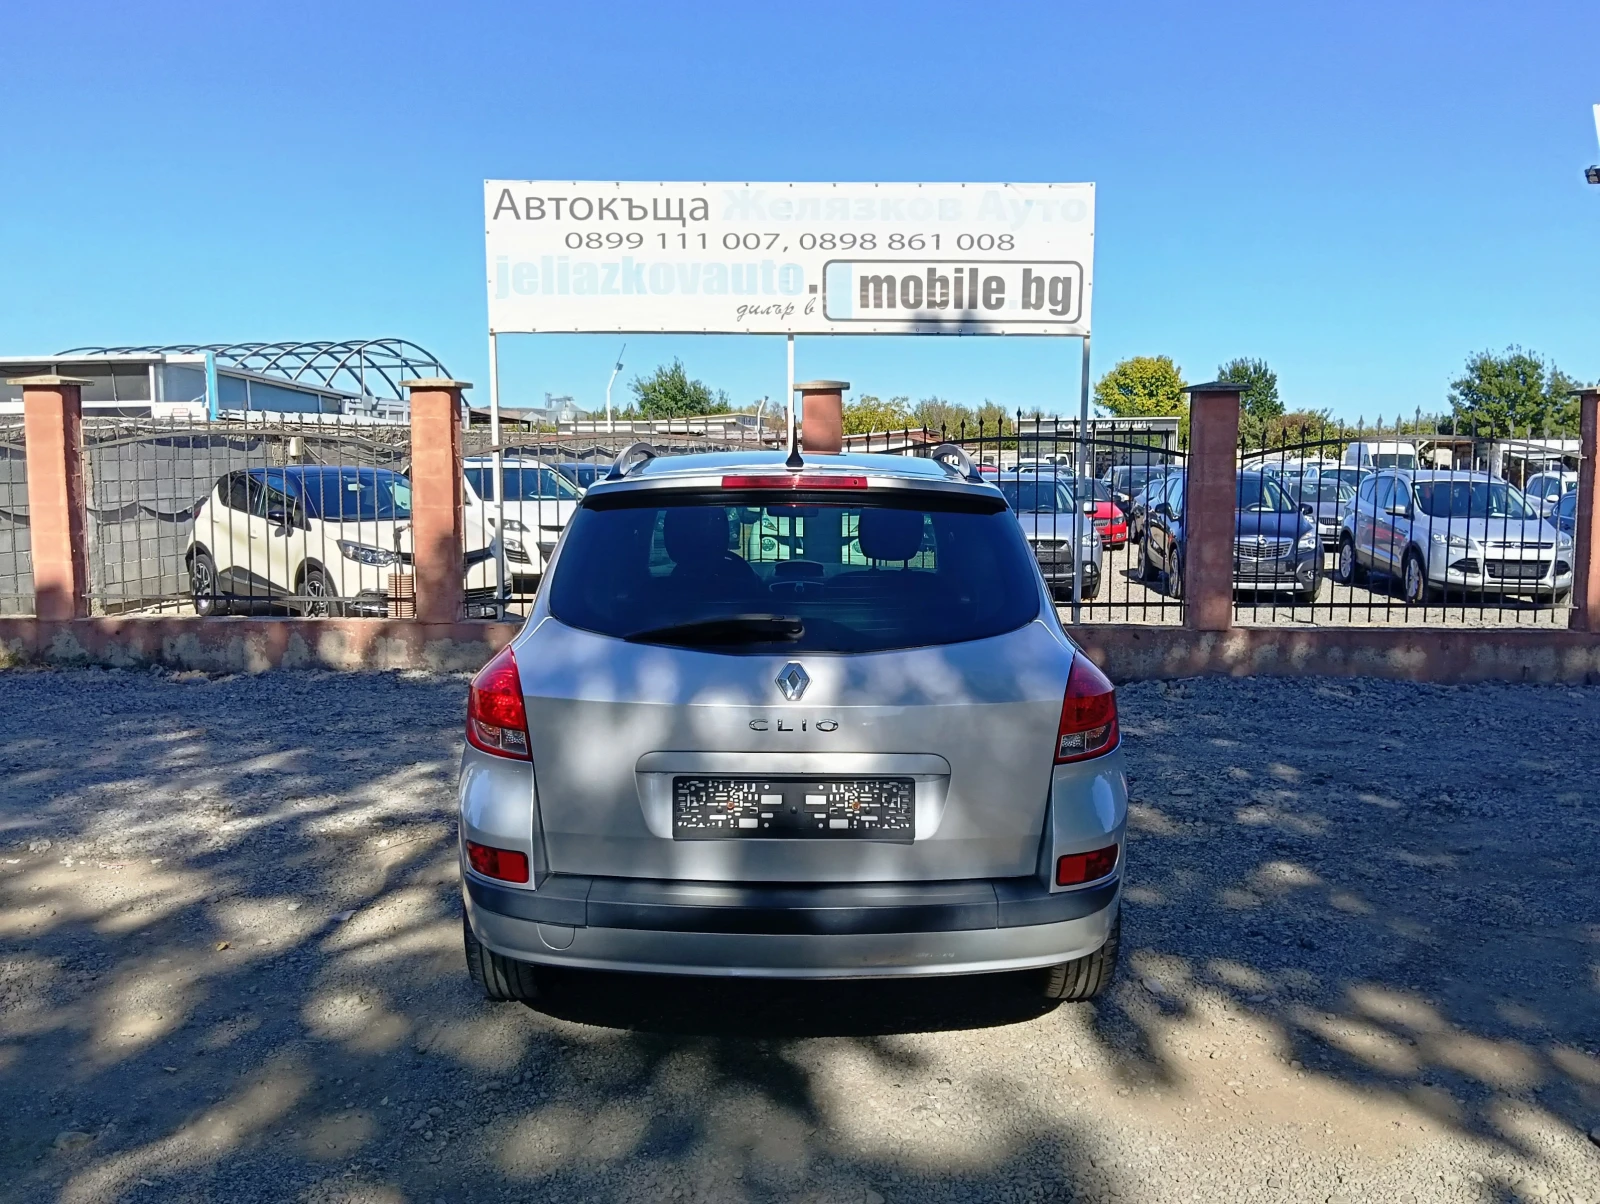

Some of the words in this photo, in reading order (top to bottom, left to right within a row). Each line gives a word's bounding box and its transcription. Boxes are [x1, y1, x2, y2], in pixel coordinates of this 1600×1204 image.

[493, 187, 709, 229] Автокъща
[722, 188, 963, 222] Желязков
[564, 231, 644, 250] 0899
[656, 231, 706, 249] 111
[722, 231, 788, 253] 007,
[798, 232, 877, 251] 0898
[887, 232, 941, 251] 861
[956, 232, 1015, 251] 008
[736, 301, 795, 322] дилър
[803, 296, 817, 316] в
[748, 718, 839, 733] CLIO
